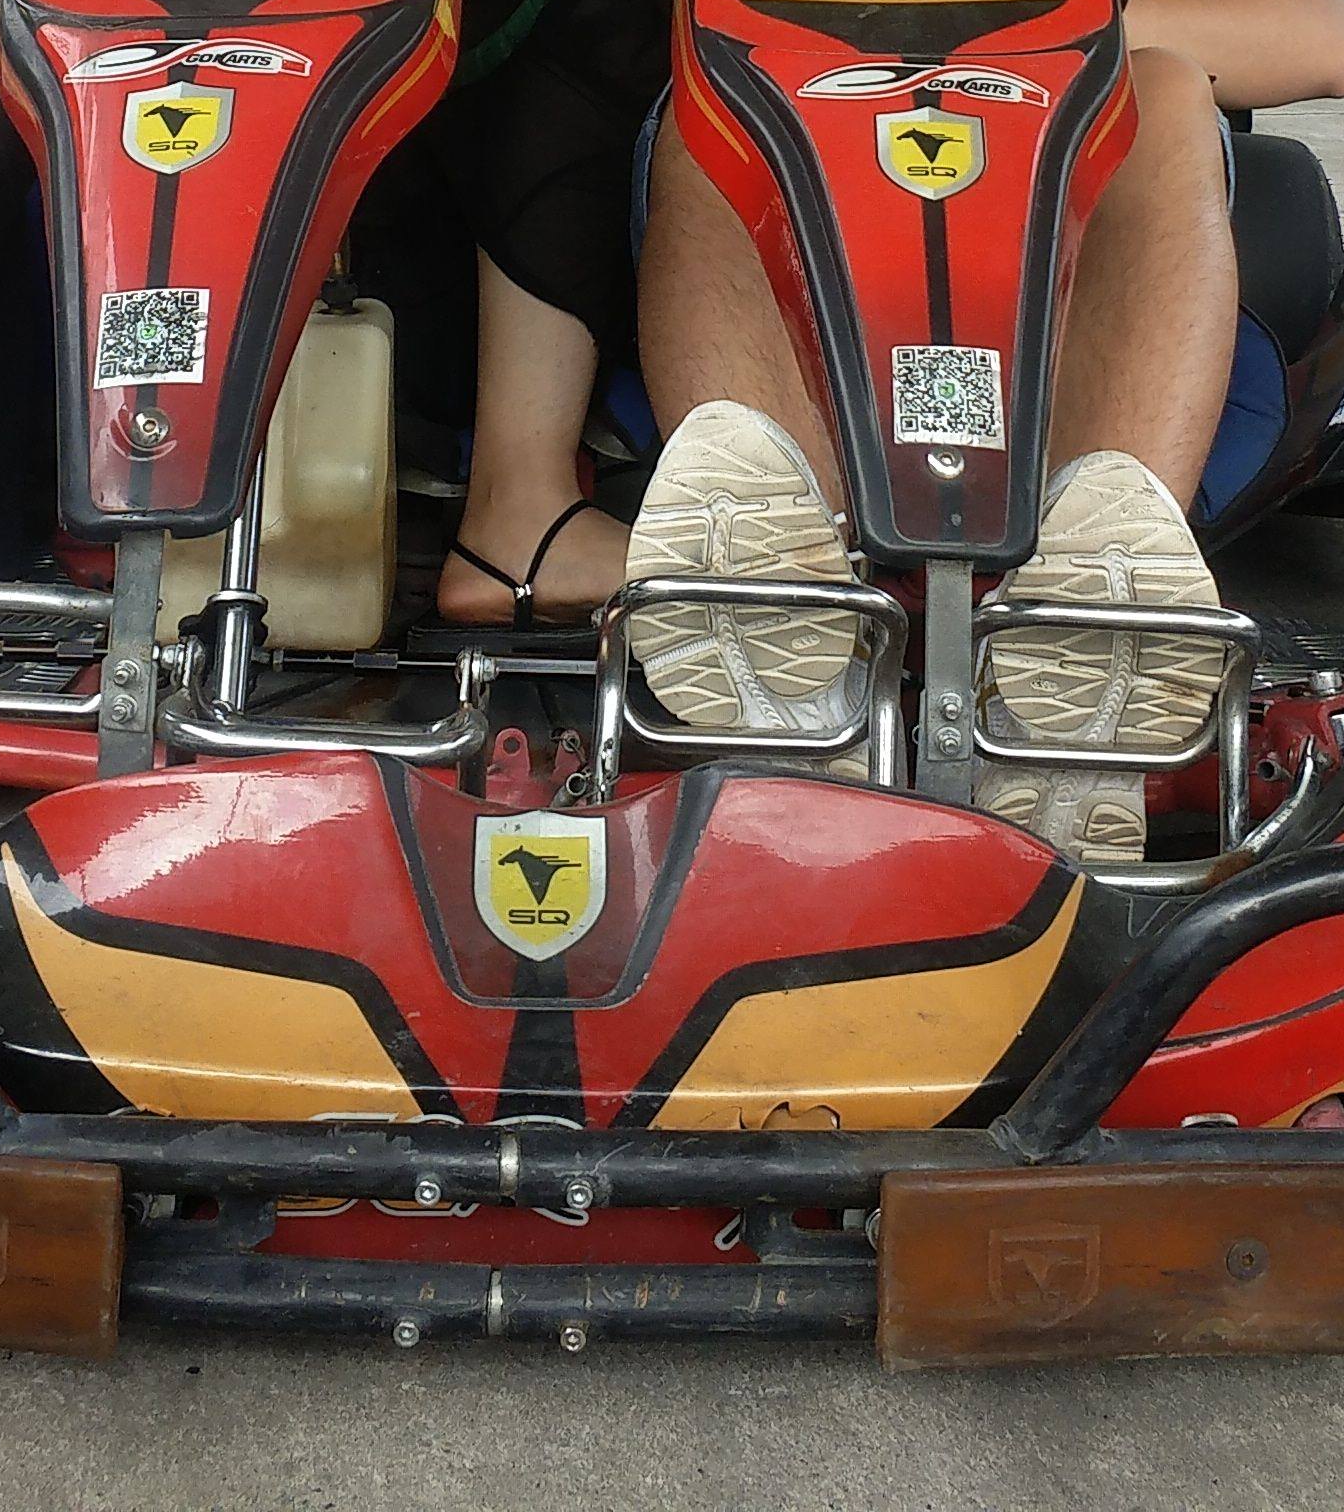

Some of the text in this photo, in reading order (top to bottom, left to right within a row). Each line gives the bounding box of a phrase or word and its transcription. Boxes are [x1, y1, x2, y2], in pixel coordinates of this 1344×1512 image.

[148, 140, 198, 152] SQ
[906, 166, 957, 178] SQ
[508, 909, 570, 925] SQ
